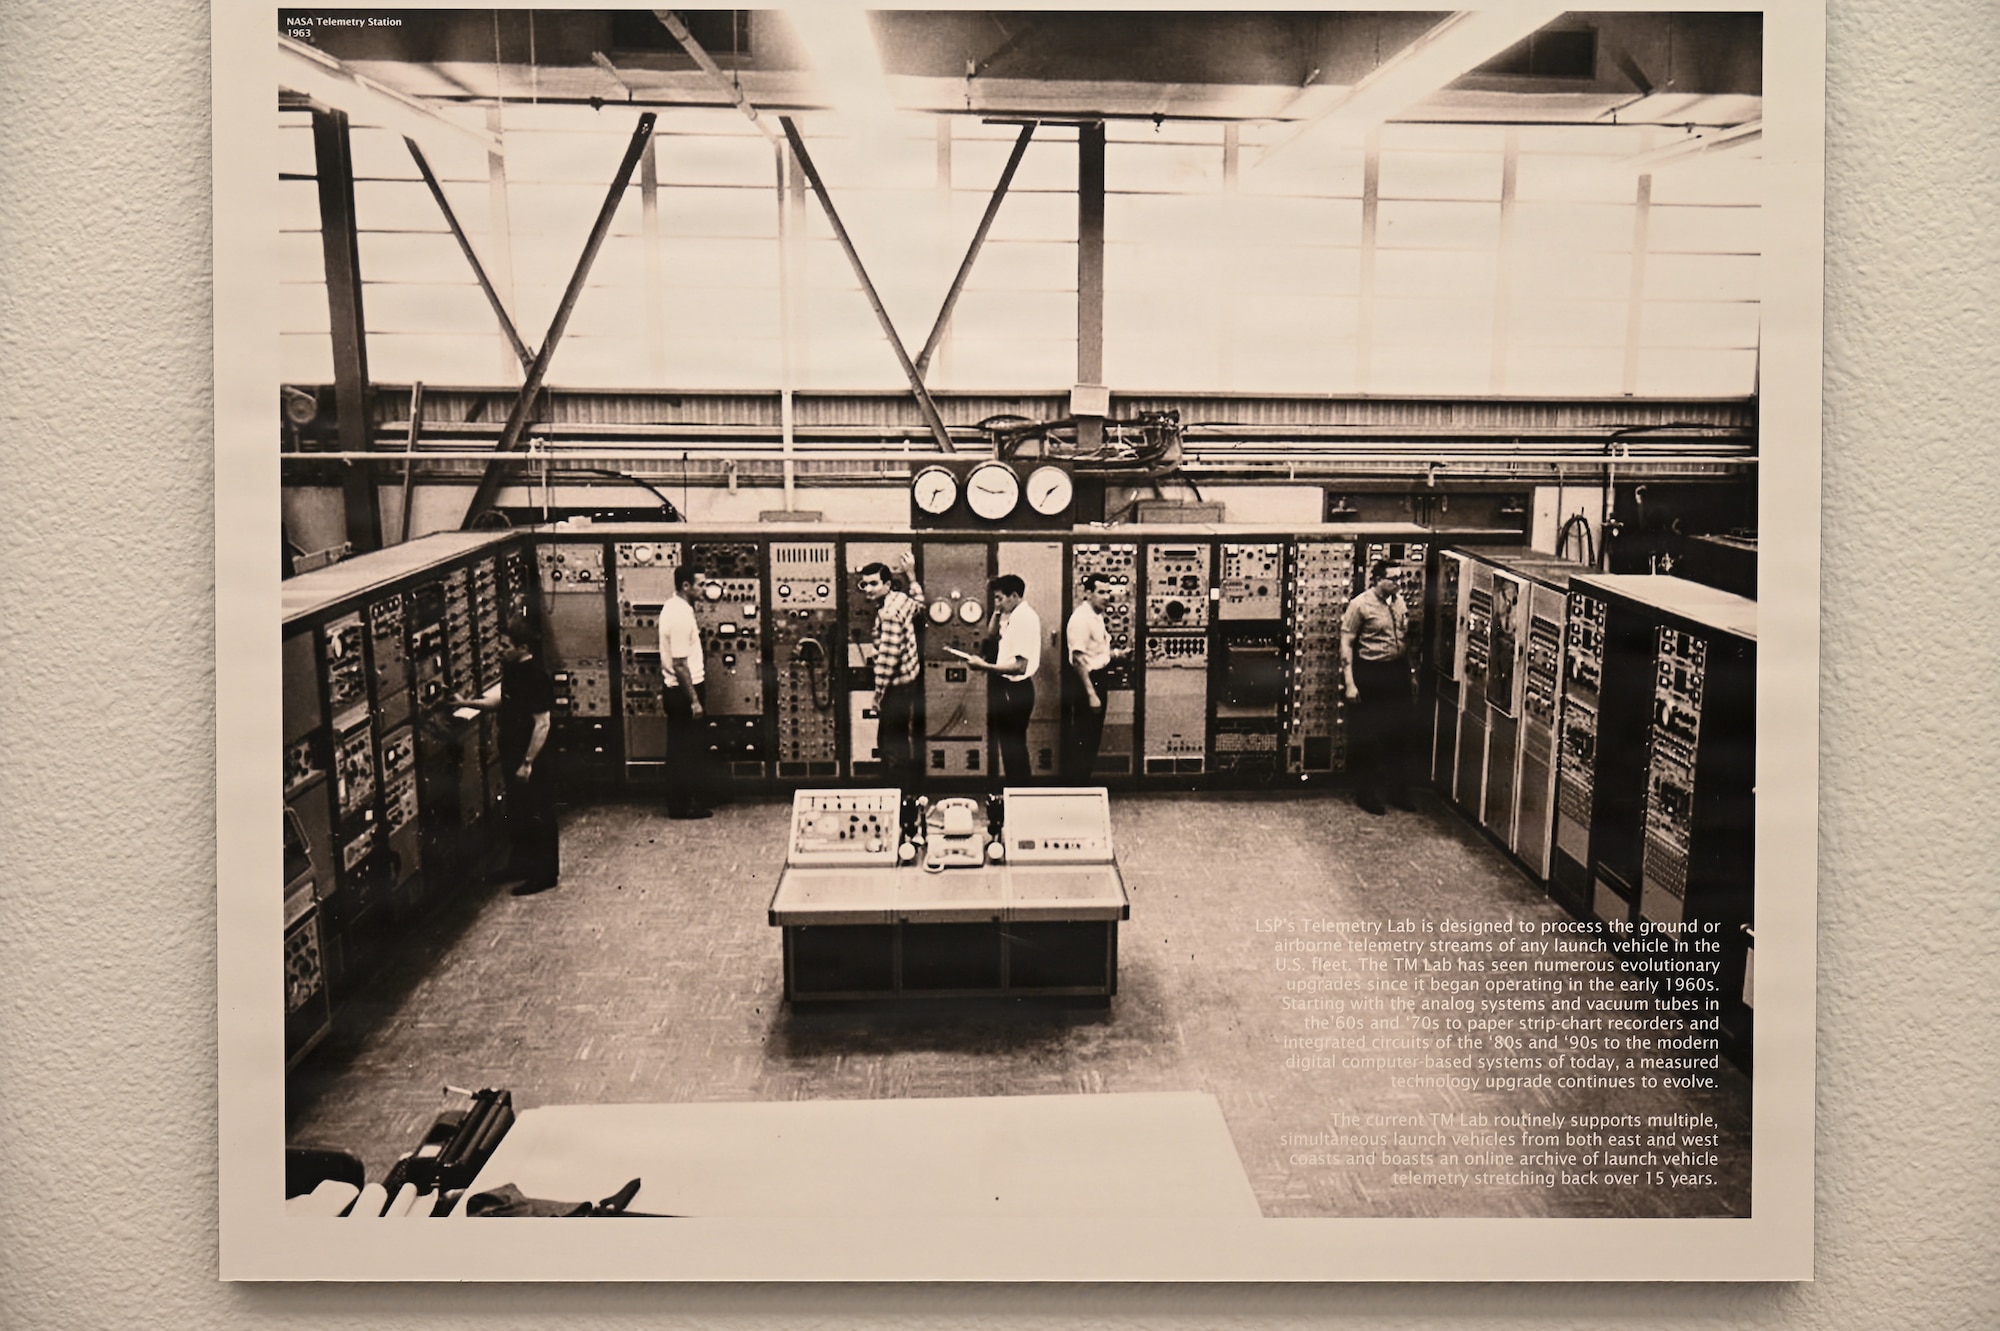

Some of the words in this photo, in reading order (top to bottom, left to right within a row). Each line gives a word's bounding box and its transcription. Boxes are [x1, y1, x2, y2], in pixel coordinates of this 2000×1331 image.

[286, 17, 314, 26] NASA
[316, 17, 365, 27] Telemetry
[367, 17, 402, 26] Station
[287, 28, 311, 37] 1963
[1303, 919, 1382, 936] Telemetry
[1388, 919, 1415, 933] Lab
[1421, 919, 1434, 933] is
[1440, 919, 1513, 936] designed
[1519, 920, 1535, 933] to
[1541, 922, 1603, 936] process
[1608, 919, 1634, 933] the
[1639, 919, 1698, 936] ground
[1703, 922, 1721, 933] or
[1274, 939, 1341, 952] airborne
[1348, 939, 1424, 955] telemetry
[1430, 940, 1493, 952] streams
[1499, 939, 1516, 952] of
[1520, 942, 1549, 955] any
[1554, 939, 1607, 952] launch
[1613, 939, 1669, 952] vehicle
[1675, 939, 1689, 952] in
[1695, 939, 1720, 952] the
[1276, 958, 1305, 972] U.S.
[1312, 958, 1352, 972] fleet.
[1358, 958, 1388, 972] The
[1393, 958, 1418, 972] TM
[1424, 958, 1452, 972] Lab
[1458, 958, 1485, 972] has
[1491, 961, 1528, 972] seen
[1534, 961, 1615, 972] numerous
[1620, 958, 1720, 975] evolutionary
[1286, 978, 1361, 994] upgrades
[1367, 978, 1408, 991] since
[1414, 978, 1425, 991] it
[1430, 978, 1479, 994] began
[1485, 978, 1562, 994] operating
[1569, 978, 1583, 991] in
[1588, 978, 1614, 991] the
[1620, 978, 1659, 994] early
[1665, 978, 1720, 991] 1960s.
[1282, 997, 1345, 1014] Starting
[1350, 997, 1384, 1011] with
[1390, 997, 1415, 1011] the
[1421, 997, 1475, 1014] analog
[1481, 998, 1545, 1014] systems
[1551, 997, 1581, 1011] and
[1586, 1000, 1649, 1011] vacuum
[1655, 997, 1699, 1011] tubes
[1705, 997, 1719, 1011] in
[1370, 1016, 1399, 1030] and
[1446, 1017, 1462, 1030] to
[1468, 1019, 1513, 1033] paper
[1519, 1016, 1602, 1033] strip-chart
[1608, 1016, 1684, 1030] recorders
[1689, 1016, 1719, 1030] and
[1284, 1035, 1366, 1052] integrated
[1371, 1035, 1429, 1049] circuits
[1435, 1035, 1452, 1049] of
[1457, 1035, 1483, 1049] the
[1528, 1035, 1558, 1049] and
[1604, 1037, 1619, 1049] to
[1626, 1035, 1651, 1049] the
[1657, 1035, 1719, 1049] modern
[1286, 1055, 1336, 1072] digital
[1342, 1055, 1472, 1072] computer-based
[1478, 1056, 1542, 1072] systems
[1549, 1055, 1565, 1069] of
[1570, 1055, 1620, 1072] today,
[1626, 1058, 1635, 1069] a
[1640, 1055, 1719, 1069] measured
[1391, 1074, 1480, 1091] technology
[1485, 1074, 1551, 1091] upgrade
[1557, 1074, 1636, 1088] continues
[1641, 1076, 1657, 1088] to
[1663, 1074, 1719, 1088] evolve.
[1330, 1113, 1360, 1127] The
[1366, 1114, 1424, 1127] current
[1429, 1113, 1454, 1127] TM
[1460, 1113, 1488, 1127] Lab
[1494, 1113, 1565, 1130] routinely
[1571, 1114, 1641, 1130] supports
[1648, 1113, 1718, 1130] multiple,
[1280, 1132, 1387, 1146] simultaneous
[1394, 1132, 1446, 1146] launch
[1451, 1132, 1516, 1146] vehicles
[1521, 1132, 1559, 1146] from
[1566, 1132, 1602, 1146] both
[1608, 1134, 1641, 1146] east
[1646, 1132, 1676, 1146] and
[1681, 1134, 1718, 1146] west
[1290, 1153, 1340, 1166] coasts
[1346, 1152, 1375, 1166] and
[1382, 1152, 1434, 1166] boasts
[1439, 1155, 1458, 1166] an
[1464, 1152, 1514, 1166] online
[1520, 1152, 1577, 1166] archive
[1582, 1152, 1599, 1166] of
[1604, 1152, 1657, 1166] launch
[1662, 1152, 1718, 1166] vehicle
[1392, 1171, 1469, 1188] telemetry
[1474, 1171, 1555, 1188] stretching
[1561, 1171, 1598, 1185] back
[1604, 1174, 1639, 1185] over
[1646, 1171, 1664, 1185] 15
[1670, 1174, 1717, 1188] years.
